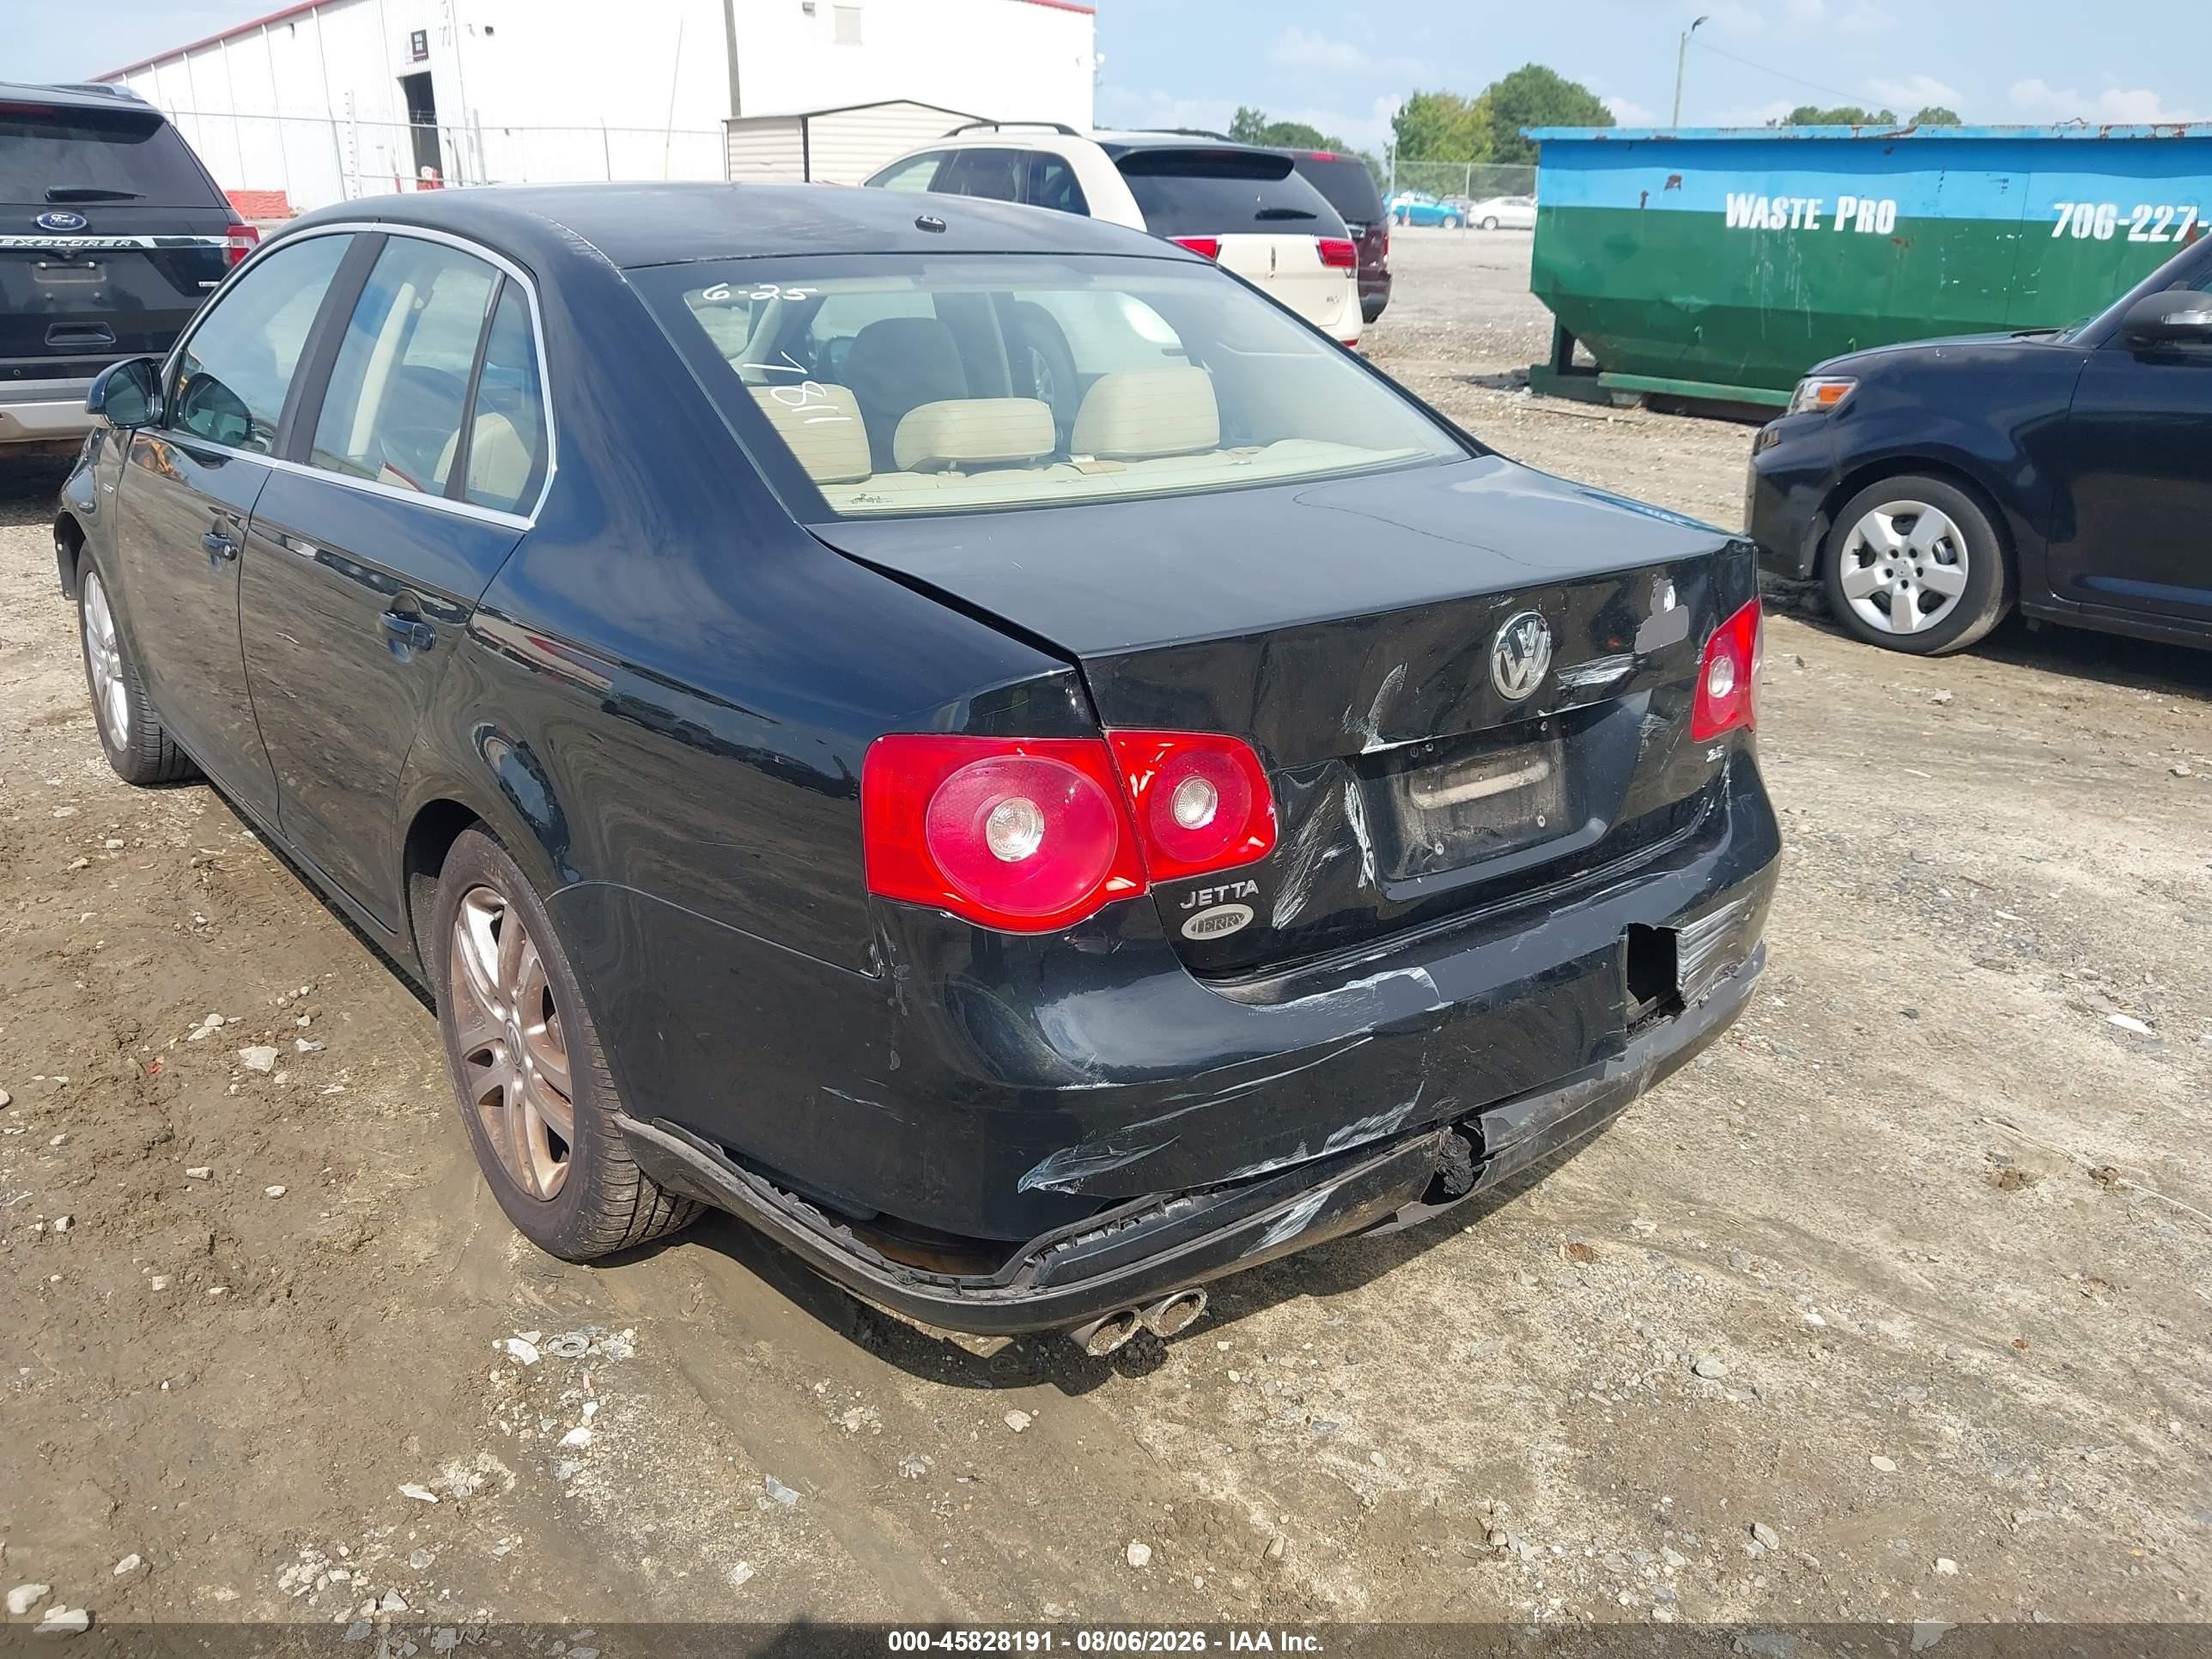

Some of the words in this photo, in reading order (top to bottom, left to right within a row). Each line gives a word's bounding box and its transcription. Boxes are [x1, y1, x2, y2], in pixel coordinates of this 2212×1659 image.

[1726, 192, 1822, 230] WASTE
[1833, 196, 1896, 234] PRO
[2051, 204, 2212, 242] 706-227-
[702, 283, 818, 301] 6-25
[1180, 879, 1260, 909] JETTA
